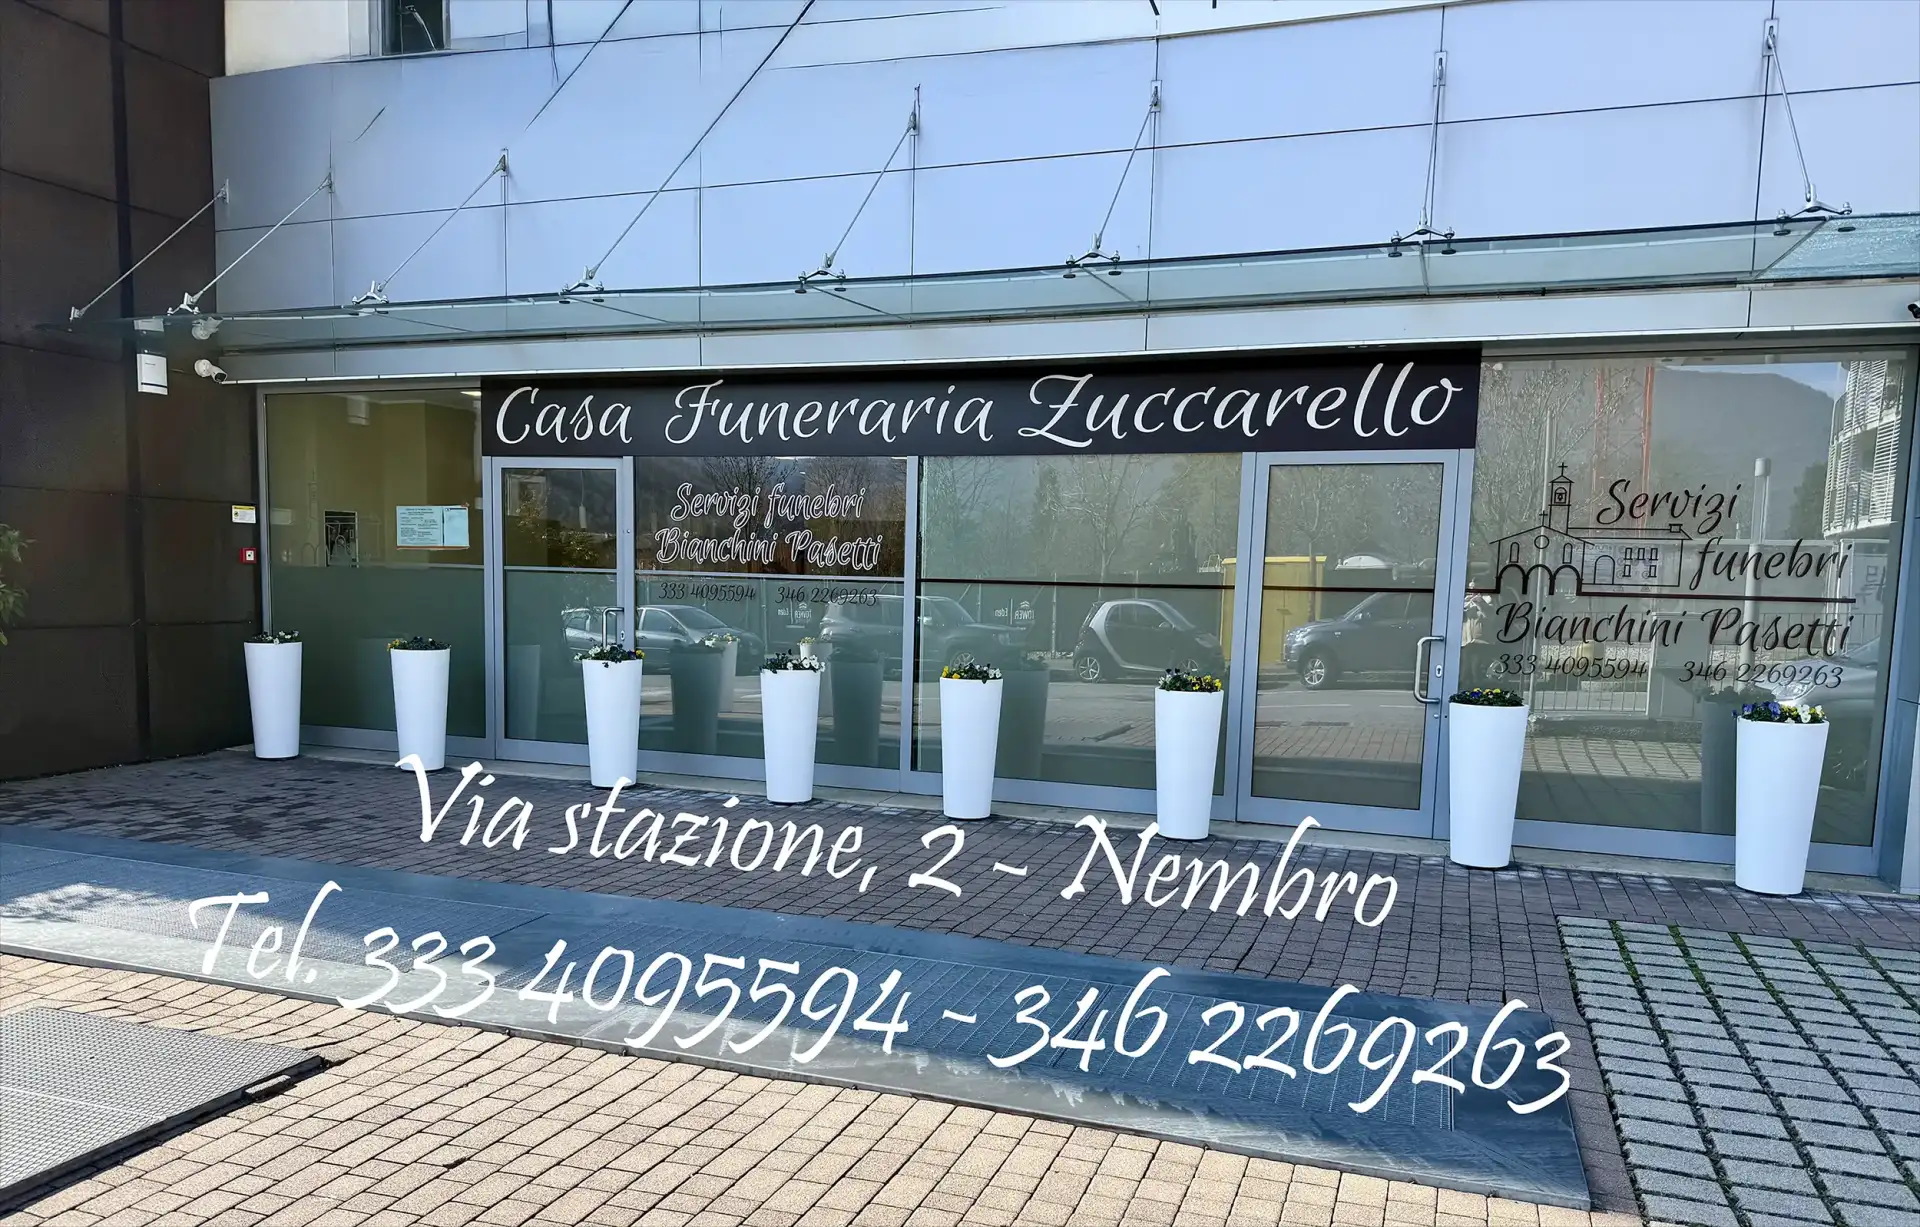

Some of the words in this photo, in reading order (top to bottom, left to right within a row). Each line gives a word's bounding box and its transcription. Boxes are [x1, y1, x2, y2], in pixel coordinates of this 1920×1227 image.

[495, 385, 633, 444] Casa
[664, 379, 994, 444] Funeraria
[1017, 361, 1464, 448] Zuccarello
[670, 482, 761, 529] Servizi
[763, 482, 866, 529] funebri
[1596, 478, 1742, 535] Servizi
[654, 526, 778, 564] Bianchini
[785, 529, 883, 571] Pasetti
[1689, 535, 1853, 591] funebri
[658, 582, 686, 600] 333
[690, 583, 756, 601] 4095594
[777, 586, 805, 604] 346
[811, 588, 878, 607] 2269263
[1496, 601, 1687, 648] Bianchini
[1700, 607, 1855, 657] Pasetti
[1495, 653, 1538, 675] 333
[1544, 655, 1648, 679] 4095594
[1679, 660, 1728, 683] 346
[1735, 663, 1844, 689] 2269263
